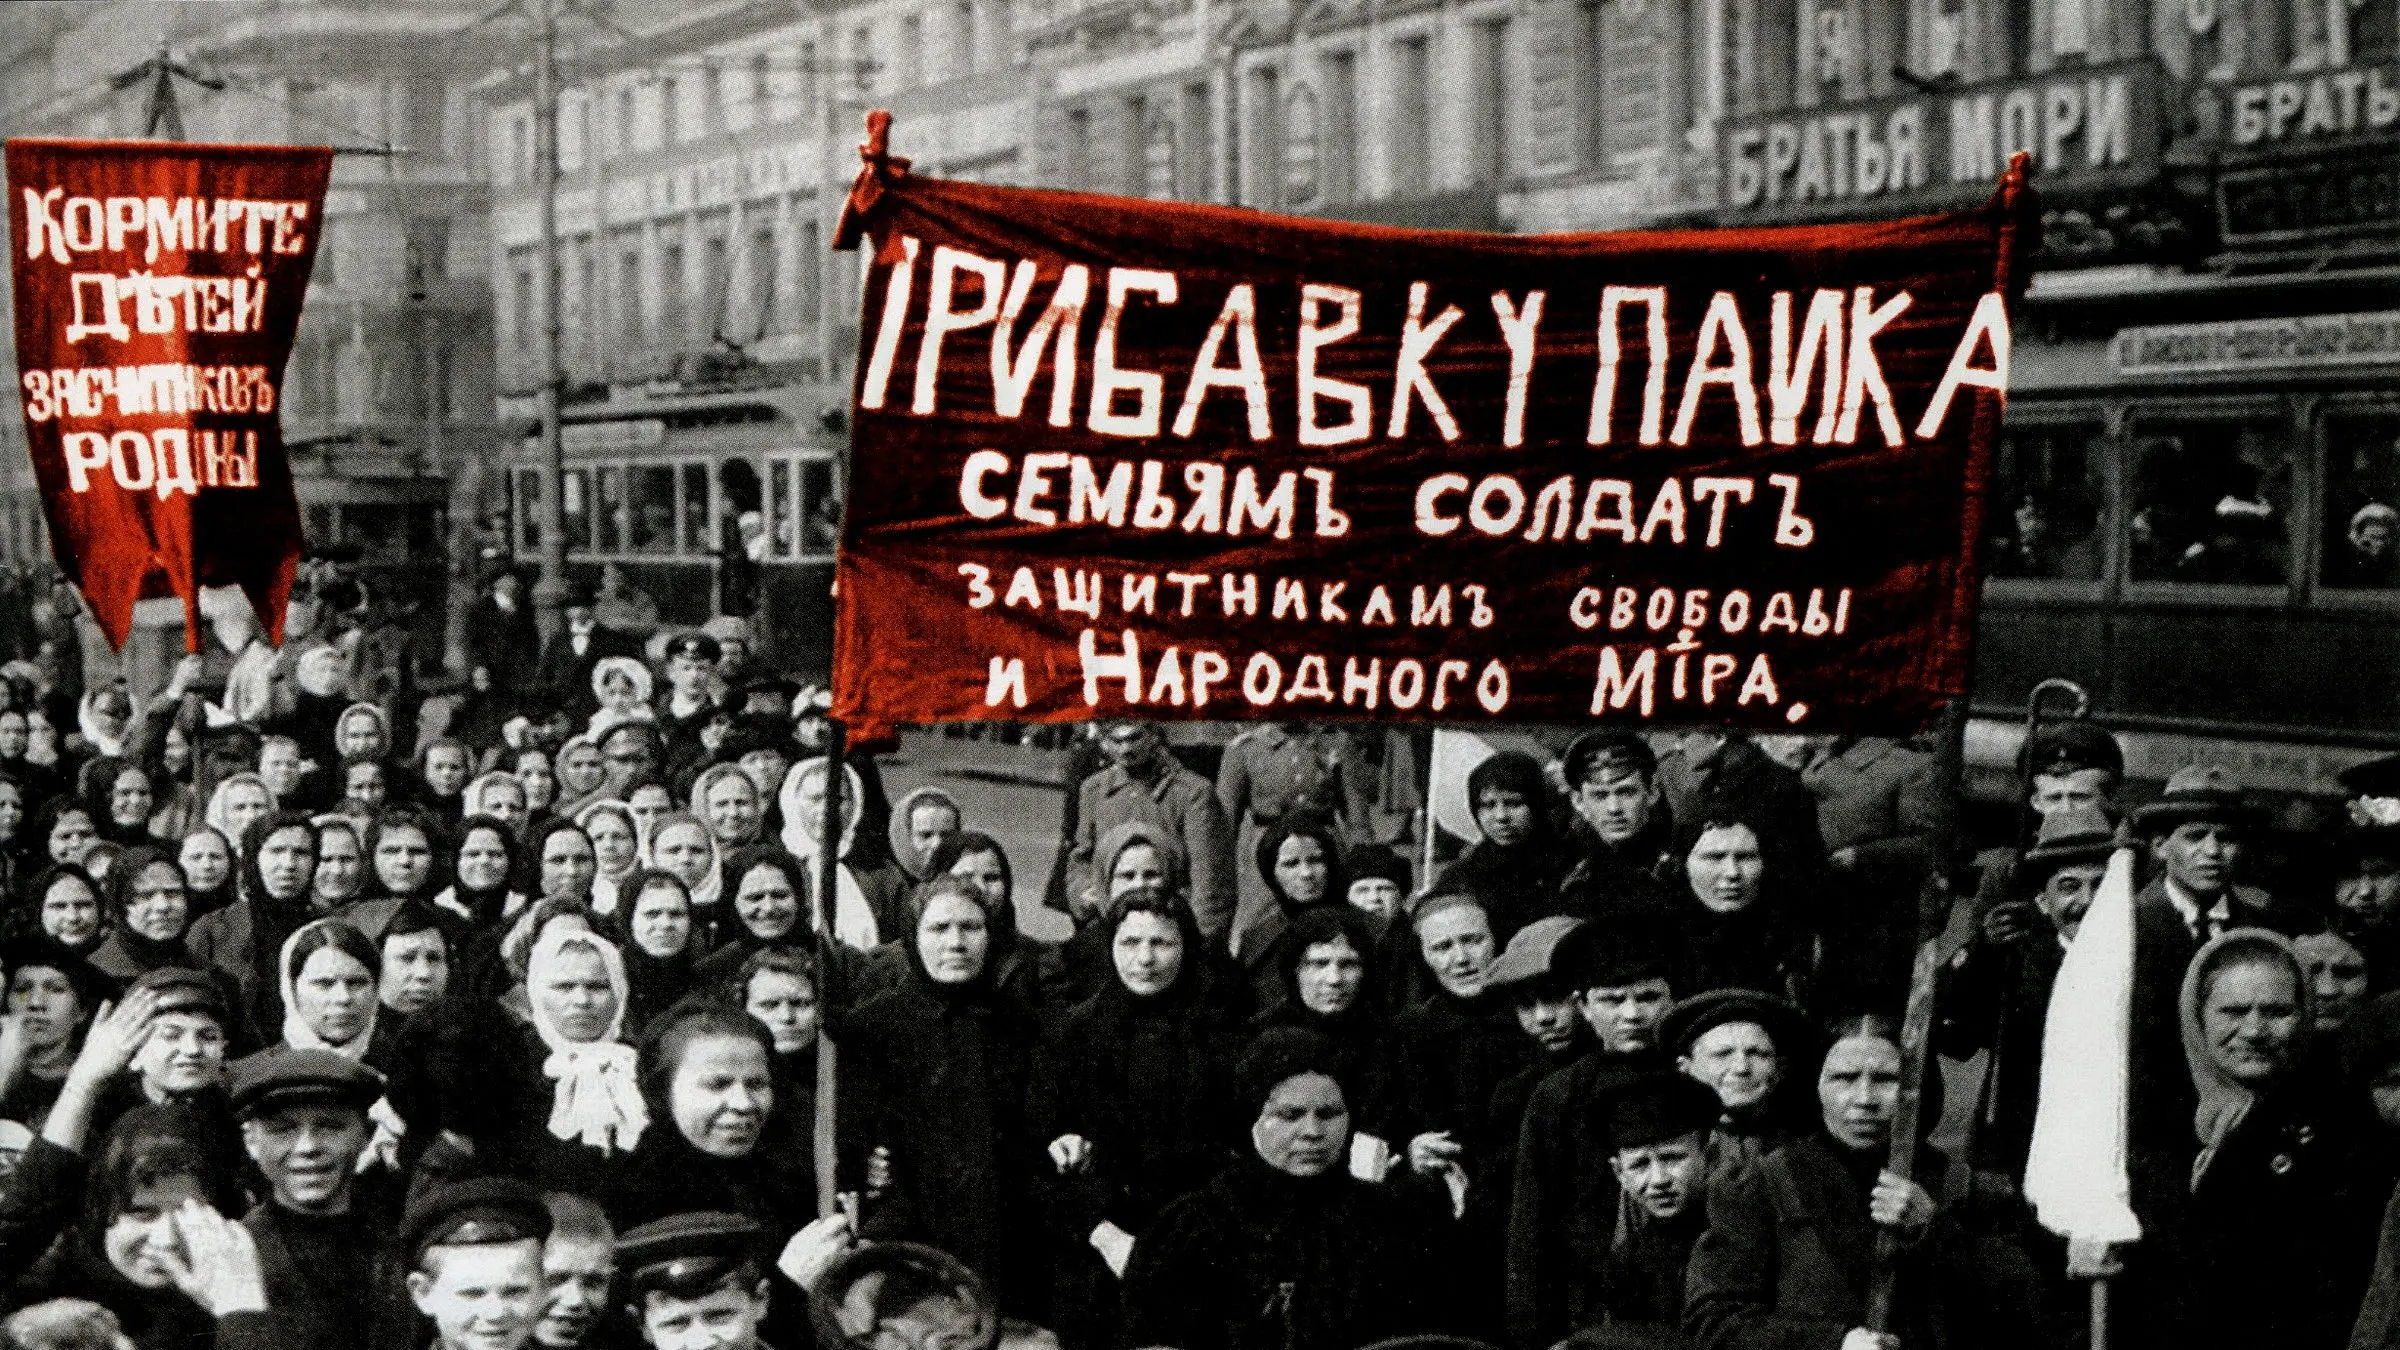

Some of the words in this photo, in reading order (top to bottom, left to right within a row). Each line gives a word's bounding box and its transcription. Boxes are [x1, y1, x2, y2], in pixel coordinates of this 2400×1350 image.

[1729, 104, 1926, 205] БРАТЬЯ
[1949, 76, 2131, 182] МОРИ
[24, 187, 308, 265] КОРМИТЕ
[958, 449, 1351, 540] СЕМЬЯМЪ
[1414, 473, 1814, 548] СОЛДАТЪ
[957, 562, 1494, 627] ЗАЩИТНИКАМЪ
[1569, 586, 1851, 637] СВОБОДЫ
[1077, 627, 1509, 714] НАРОДНОГО
